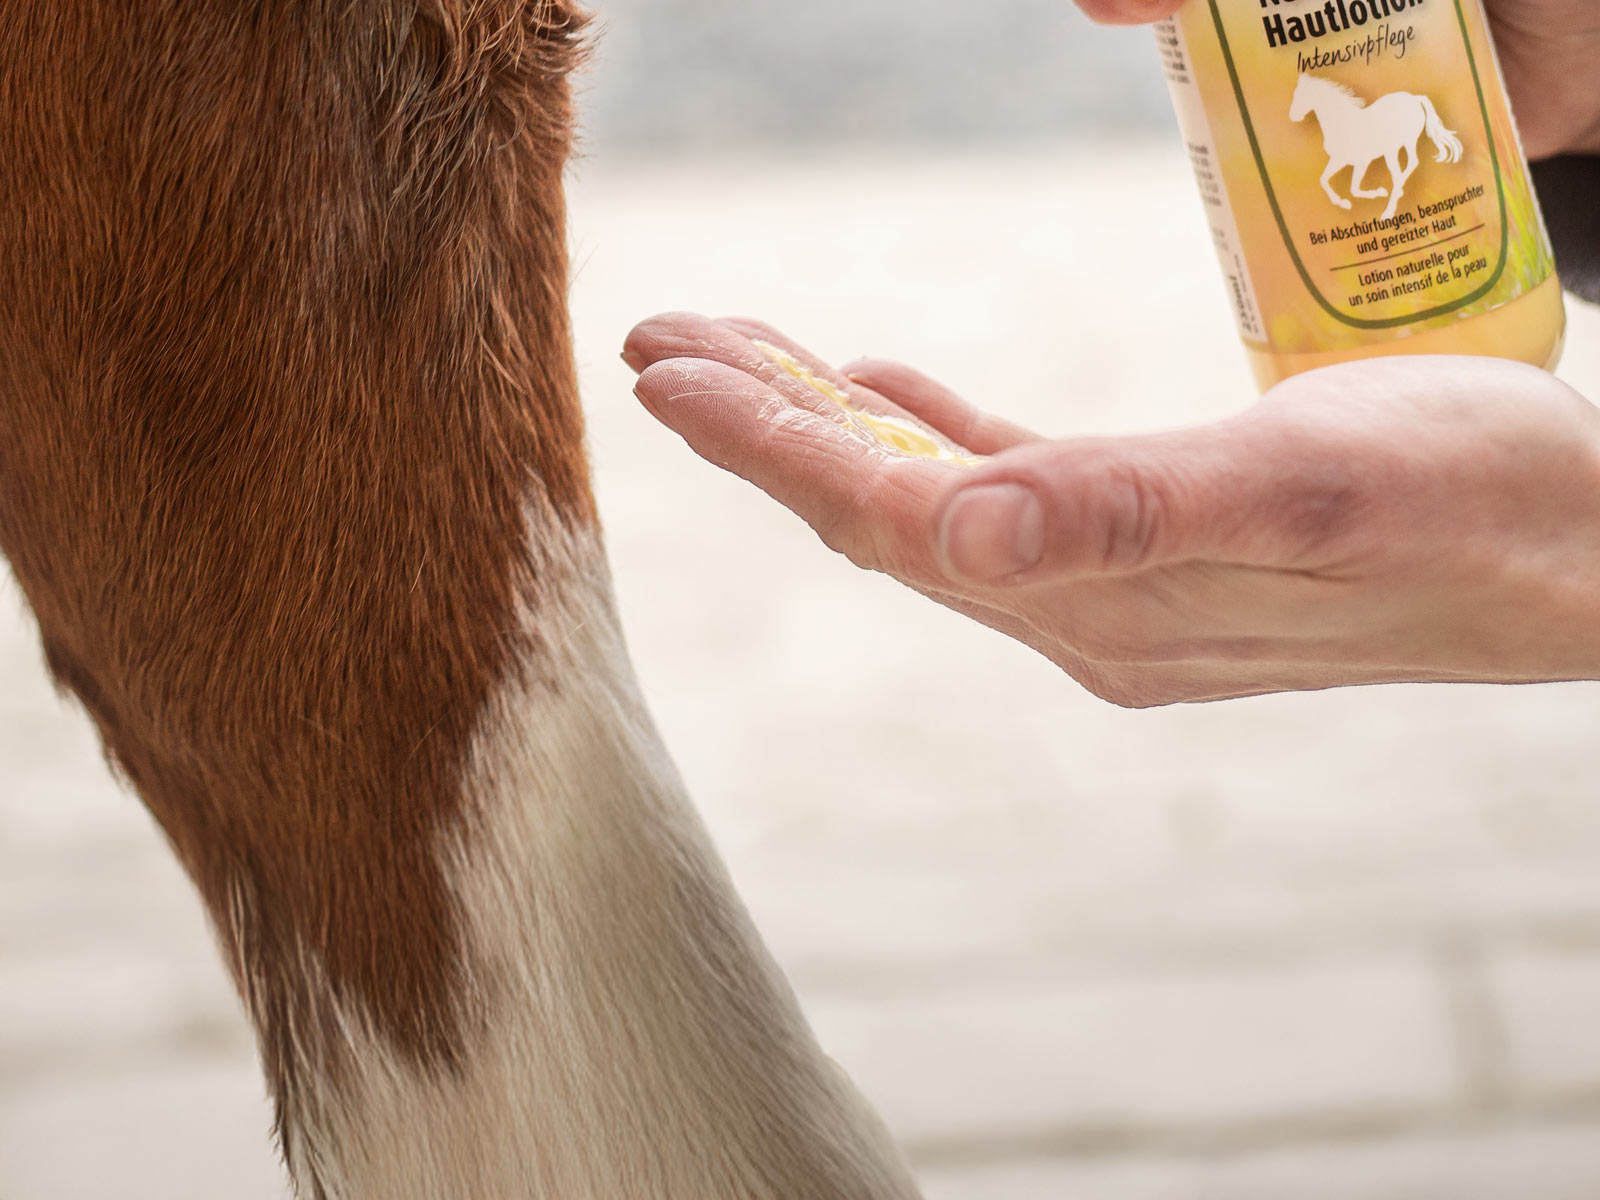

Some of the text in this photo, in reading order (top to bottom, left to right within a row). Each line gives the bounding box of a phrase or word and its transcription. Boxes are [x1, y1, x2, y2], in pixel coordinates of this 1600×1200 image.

[1296, 24, 1416, 73] Intensivpflege
[1309, 184, 1485, 246] Bei Abschürfungen, beanspruchter
[1356, 215, 1457, 254] und gereizter Haut
[1349, 256, 1487, 307] un soin intensif de la peau
[1358, 243, 1470, 287] Lotion naturelle pour
